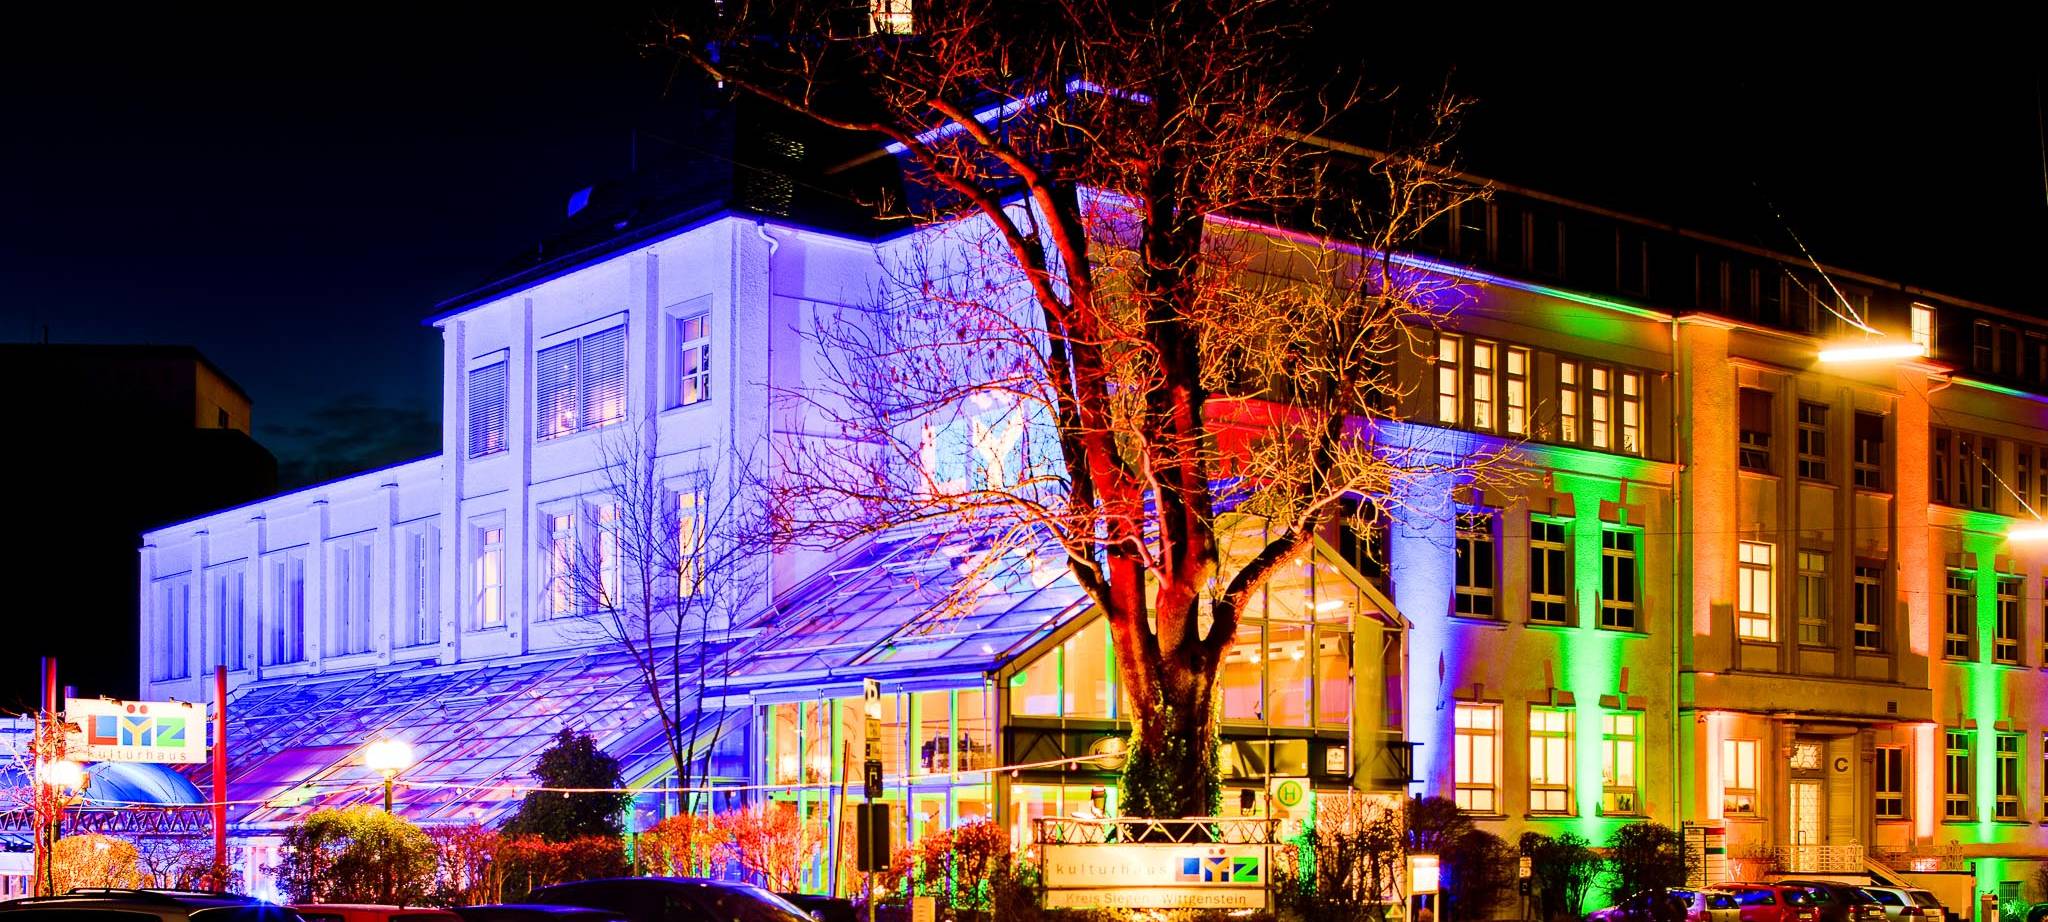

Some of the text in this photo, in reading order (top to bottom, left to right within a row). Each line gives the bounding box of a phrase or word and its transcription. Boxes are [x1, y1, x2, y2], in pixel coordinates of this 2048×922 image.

[1834, 757, 1849, 772] C
[1284, 786, 1296, 801] H
[1066, 893, 1100, 904] Kreis
[1162, 893, 1247, 906] Wittgenstein
